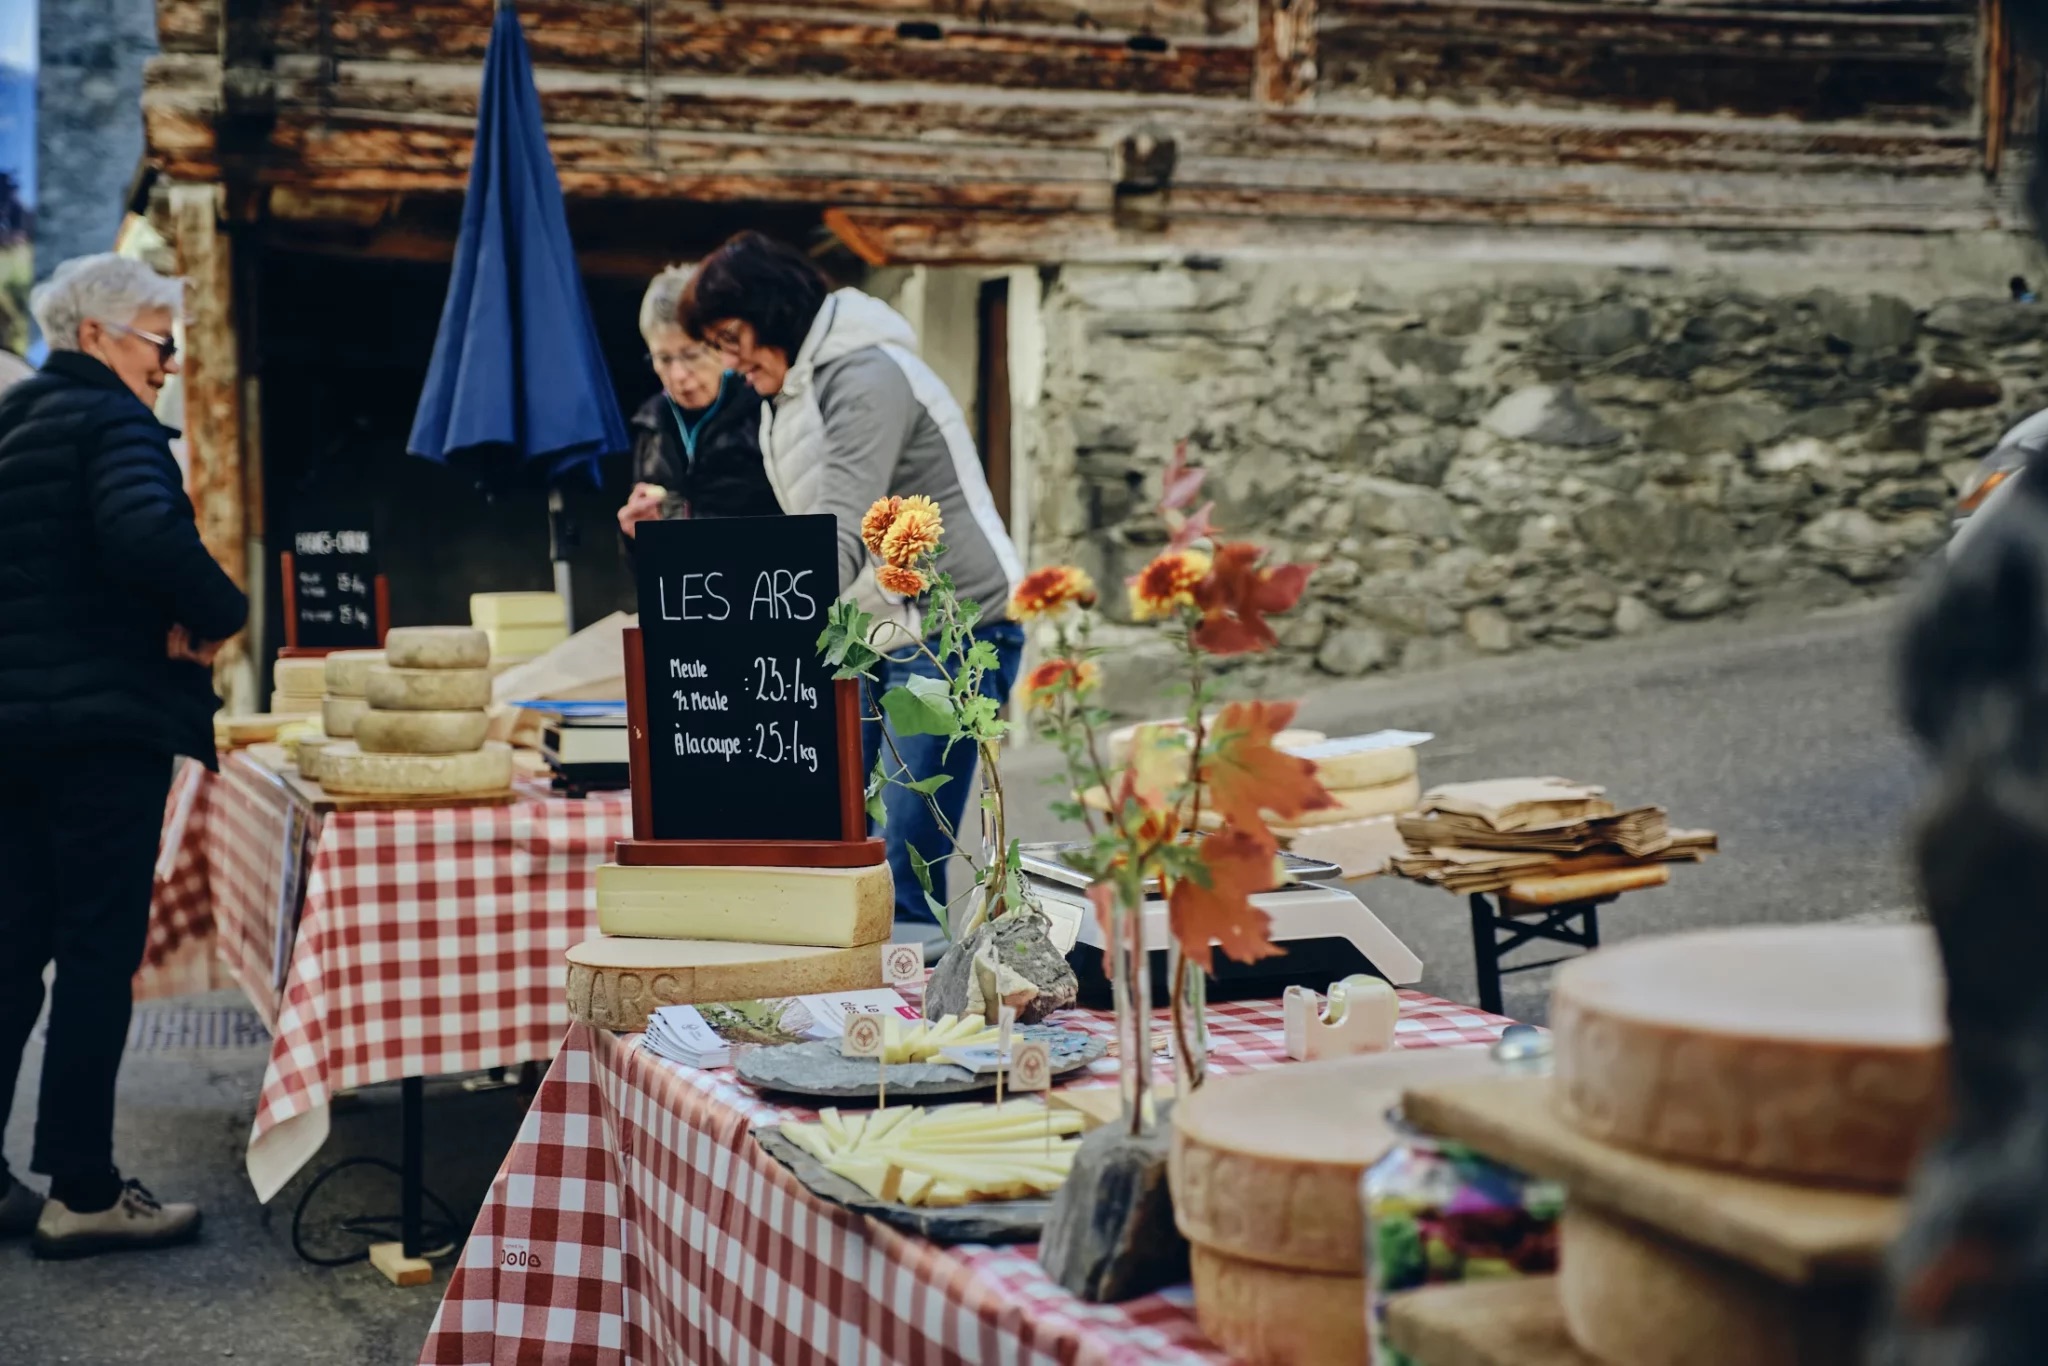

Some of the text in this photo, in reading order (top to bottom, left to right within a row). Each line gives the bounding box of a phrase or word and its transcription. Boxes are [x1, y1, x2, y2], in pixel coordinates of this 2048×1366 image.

[659, 569, 816, 621] LES ARS
[670, 658, 708, 679] Meule
[690, 690, 729, 711] Meule
